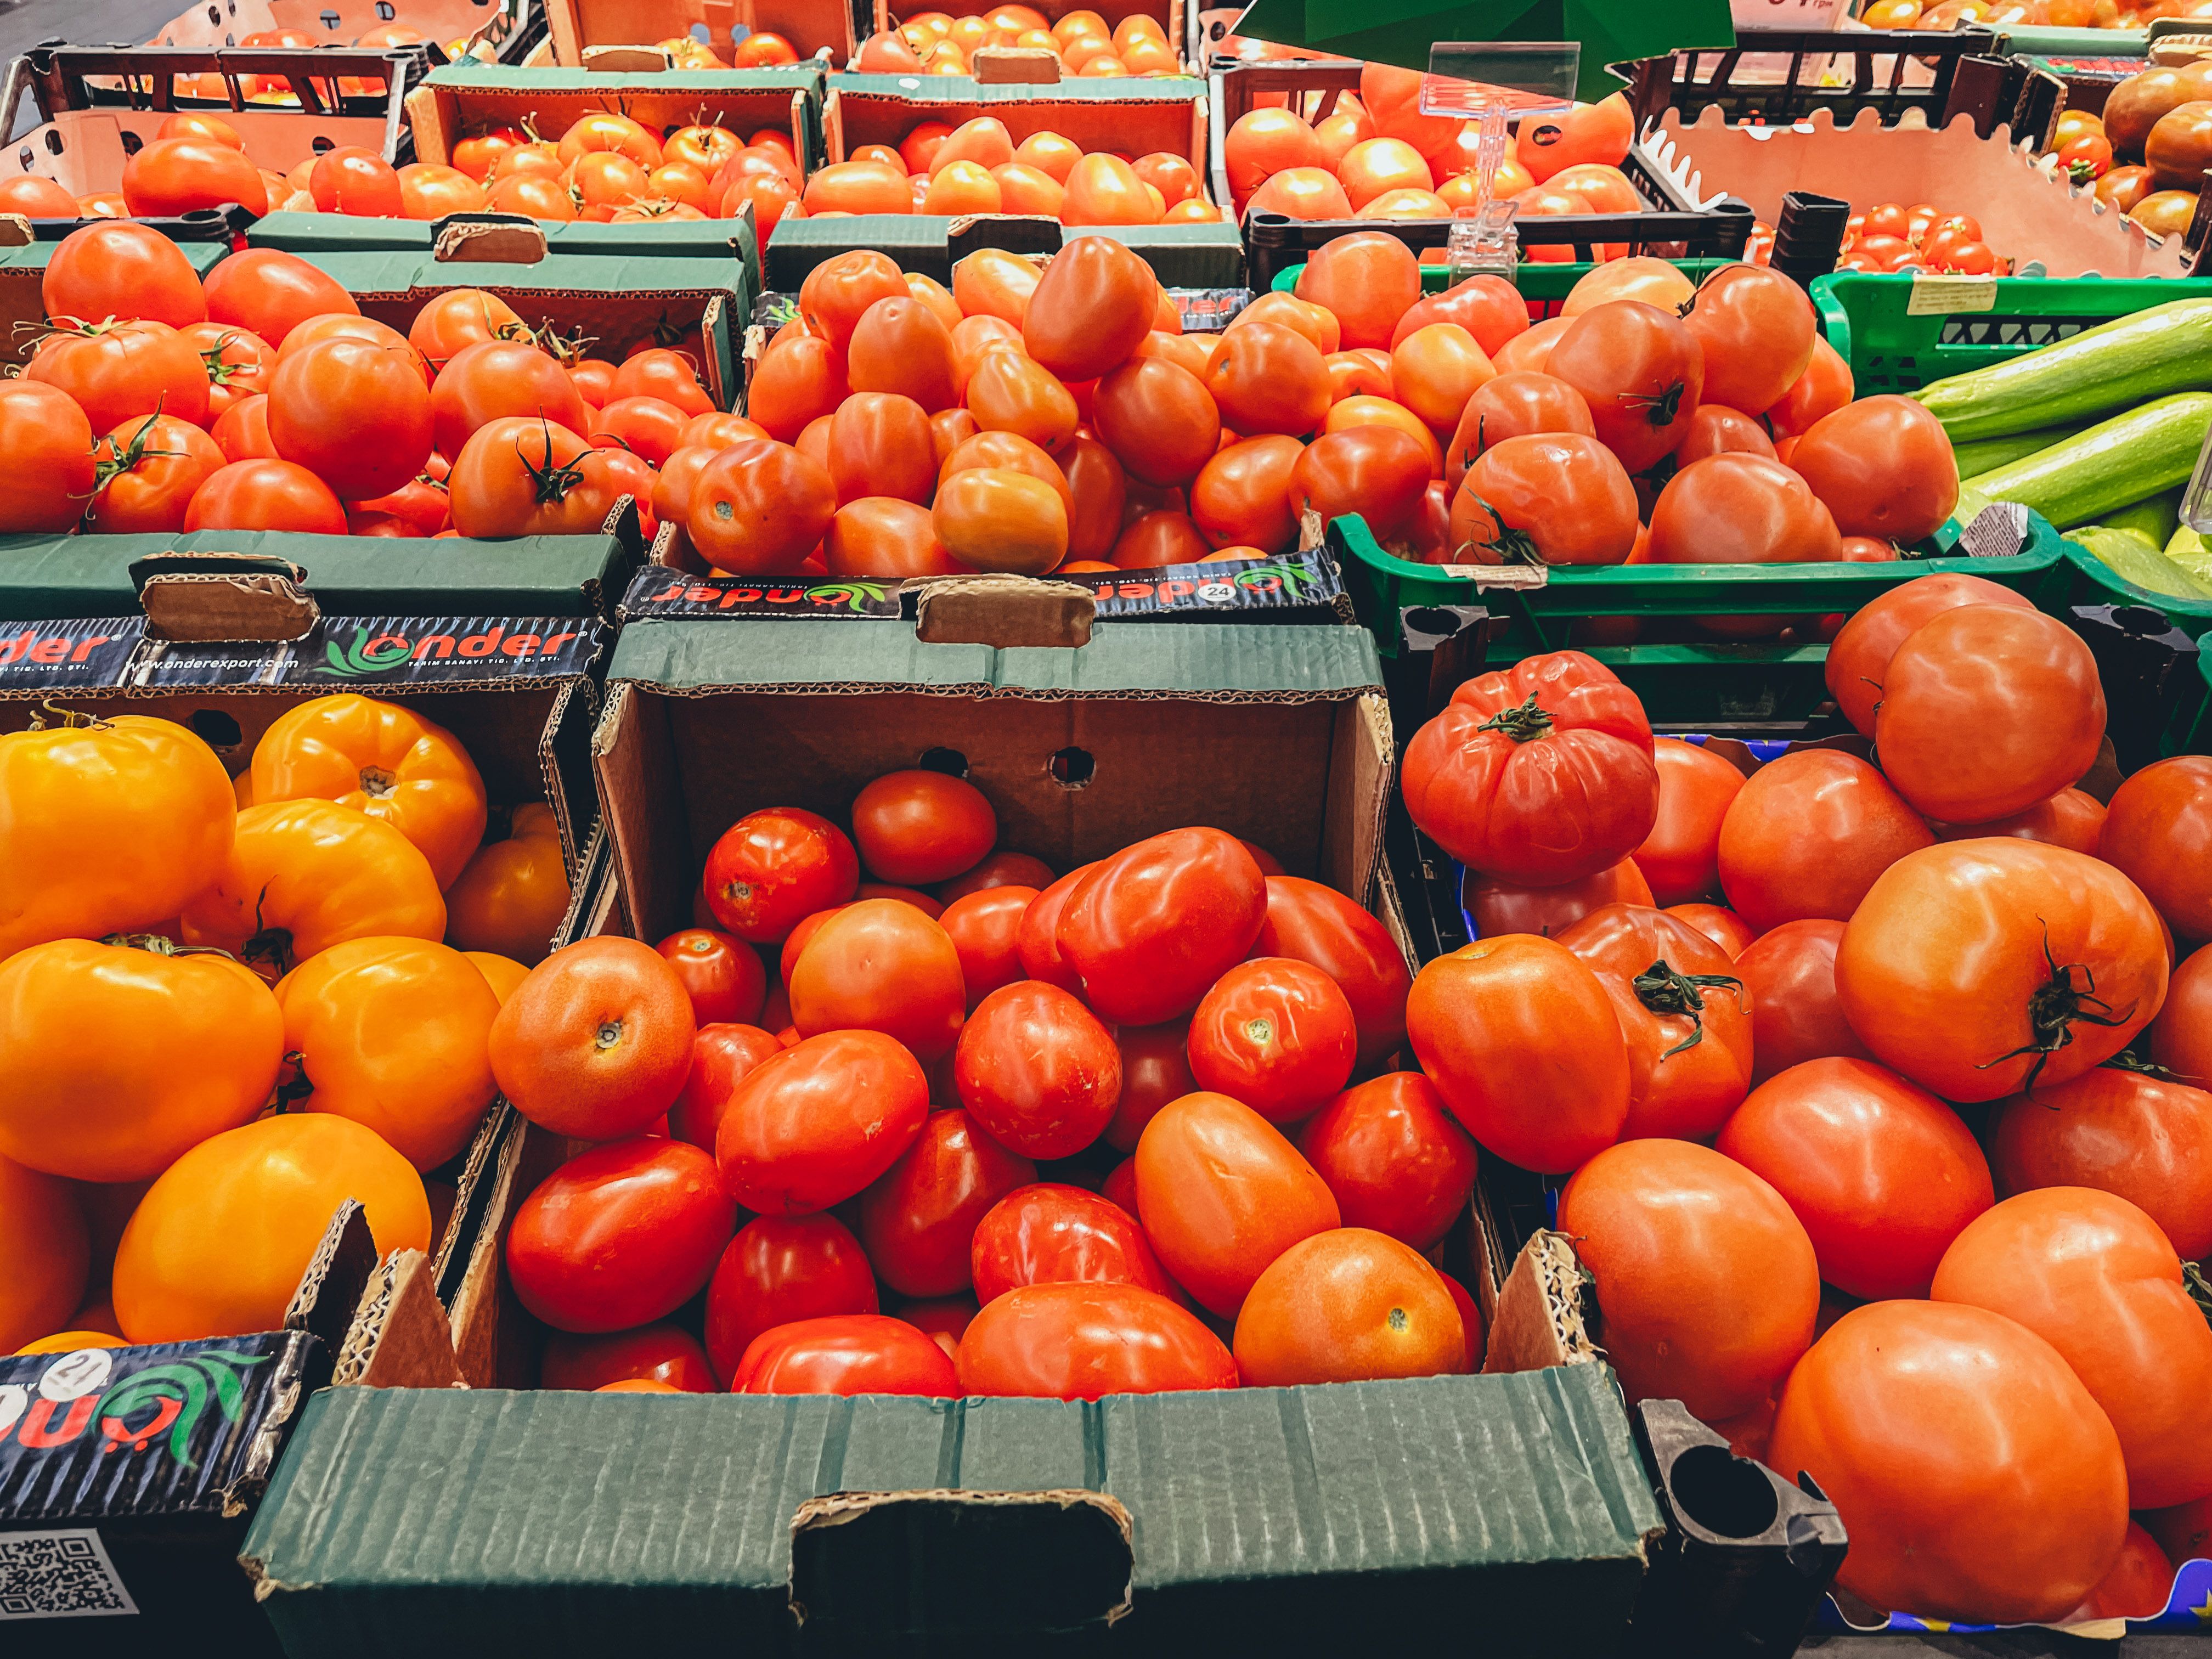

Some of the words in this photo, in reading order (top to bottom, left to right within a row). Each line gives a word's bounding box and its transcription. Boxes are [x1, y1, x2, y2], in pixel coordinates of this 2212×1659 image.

[1207, 586, 1230, 596] 24
[363, 627, 576, 658] önder
[125, 657, 299, 673] www.onderexport.com
